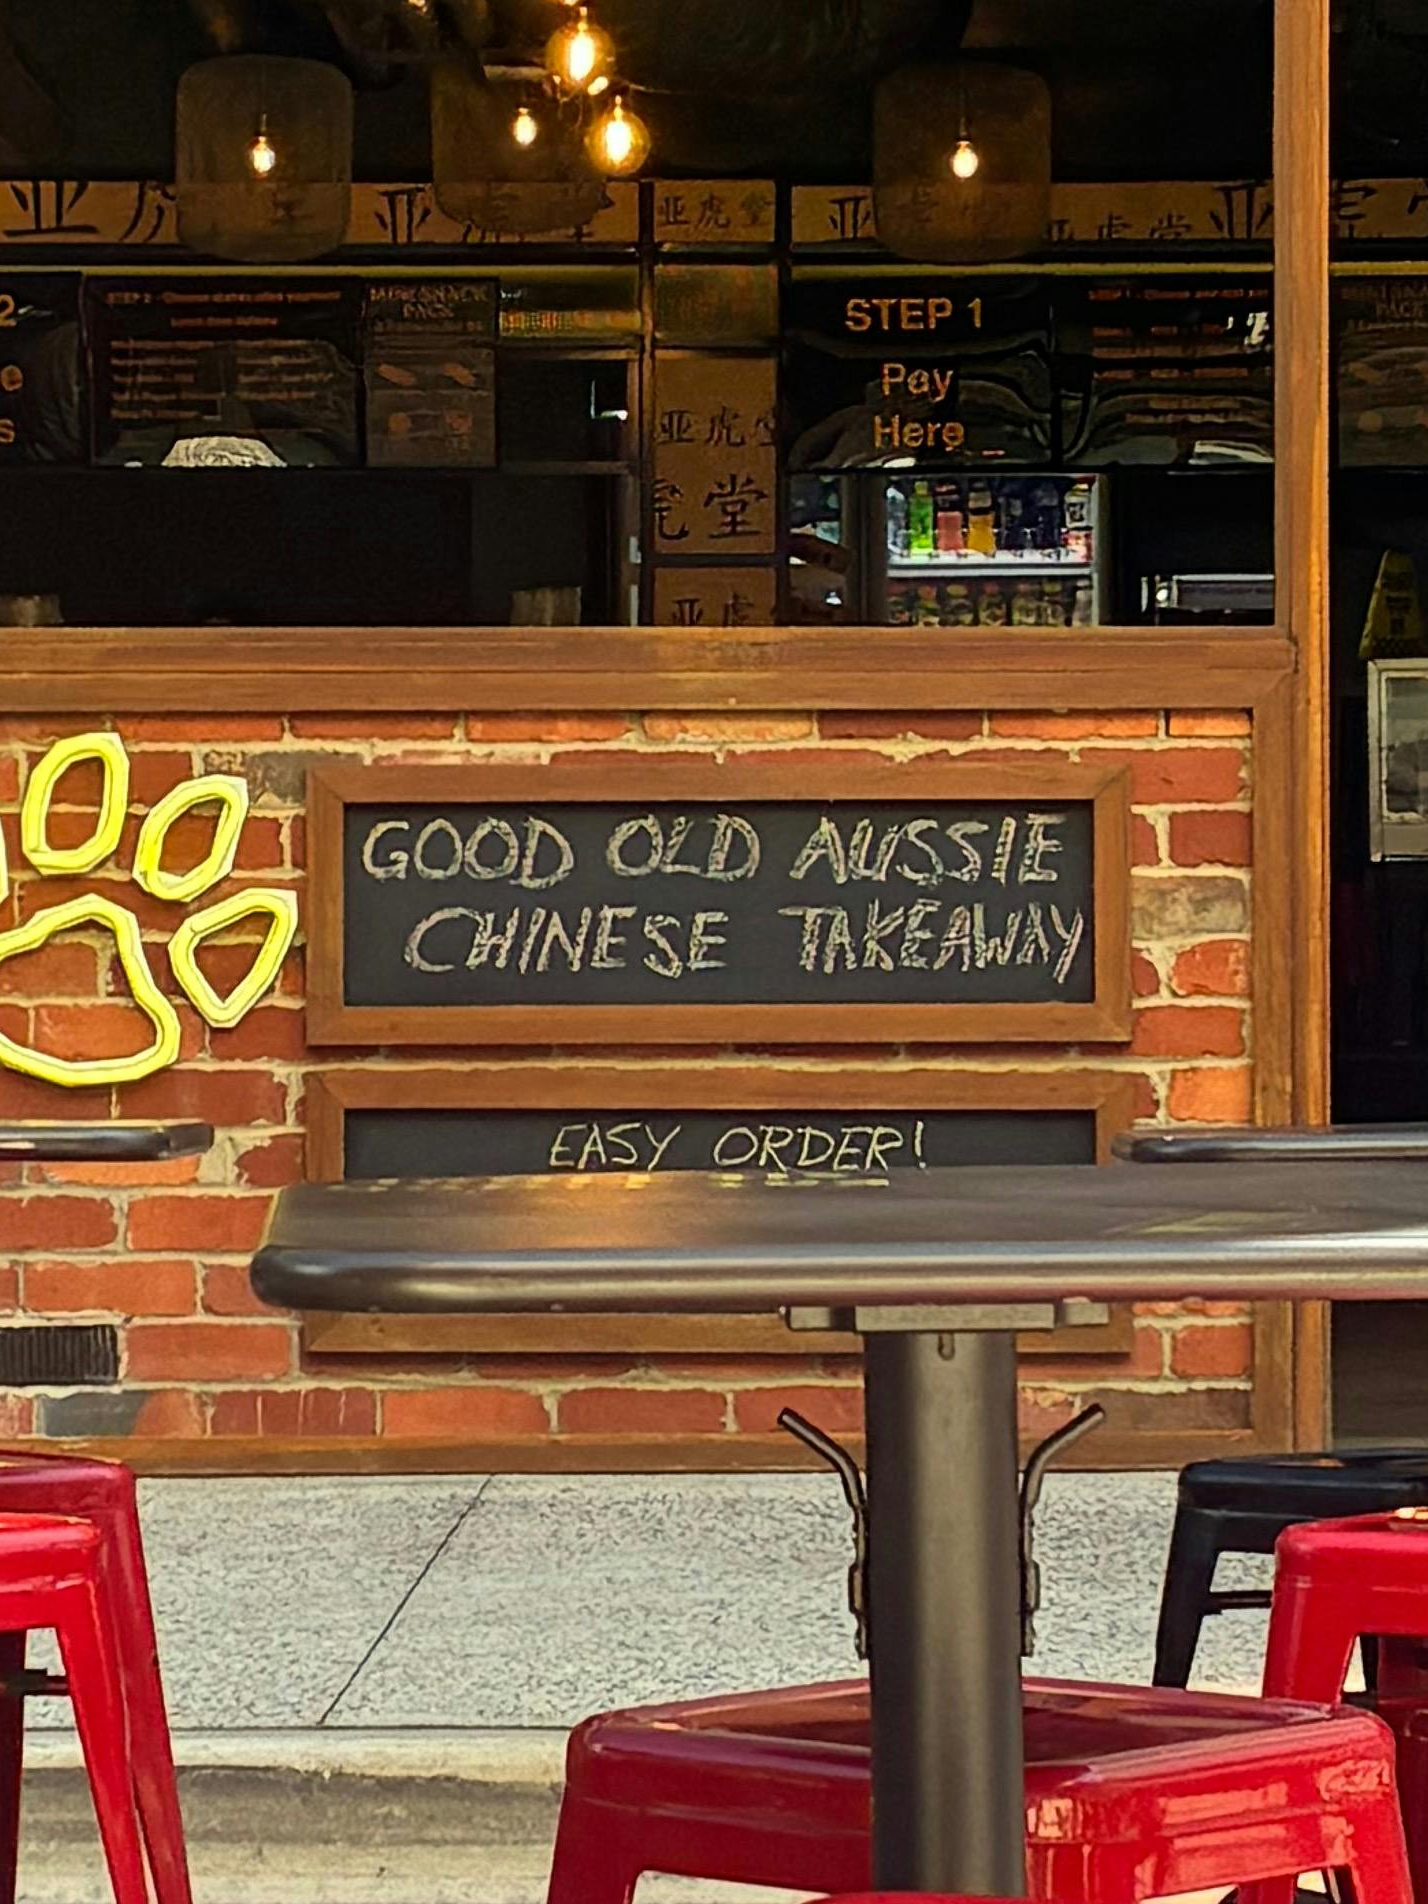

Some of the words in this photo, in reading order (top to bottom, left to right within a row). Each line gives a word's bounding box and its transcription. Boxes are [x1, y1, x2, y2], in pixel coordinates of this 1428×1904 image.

[844, 296, 953, 333] STEP
[968, 296, 983, 330] 1
[881, 361, 956, 403] Pay
[873, 413, 965, 448] Here
[361, 815, 575, 889] GOOD
[604, 812, 763, 884] OLD
[788, 812, 1069, 886] AUSSIE
[404, 904, 732, 980] CHINESE
[777, 898, 1085, 985] TAKEAWAY
[548, 1120, 681, 1173] EASY
[713, 1119, 928, 1174] ORDER!
